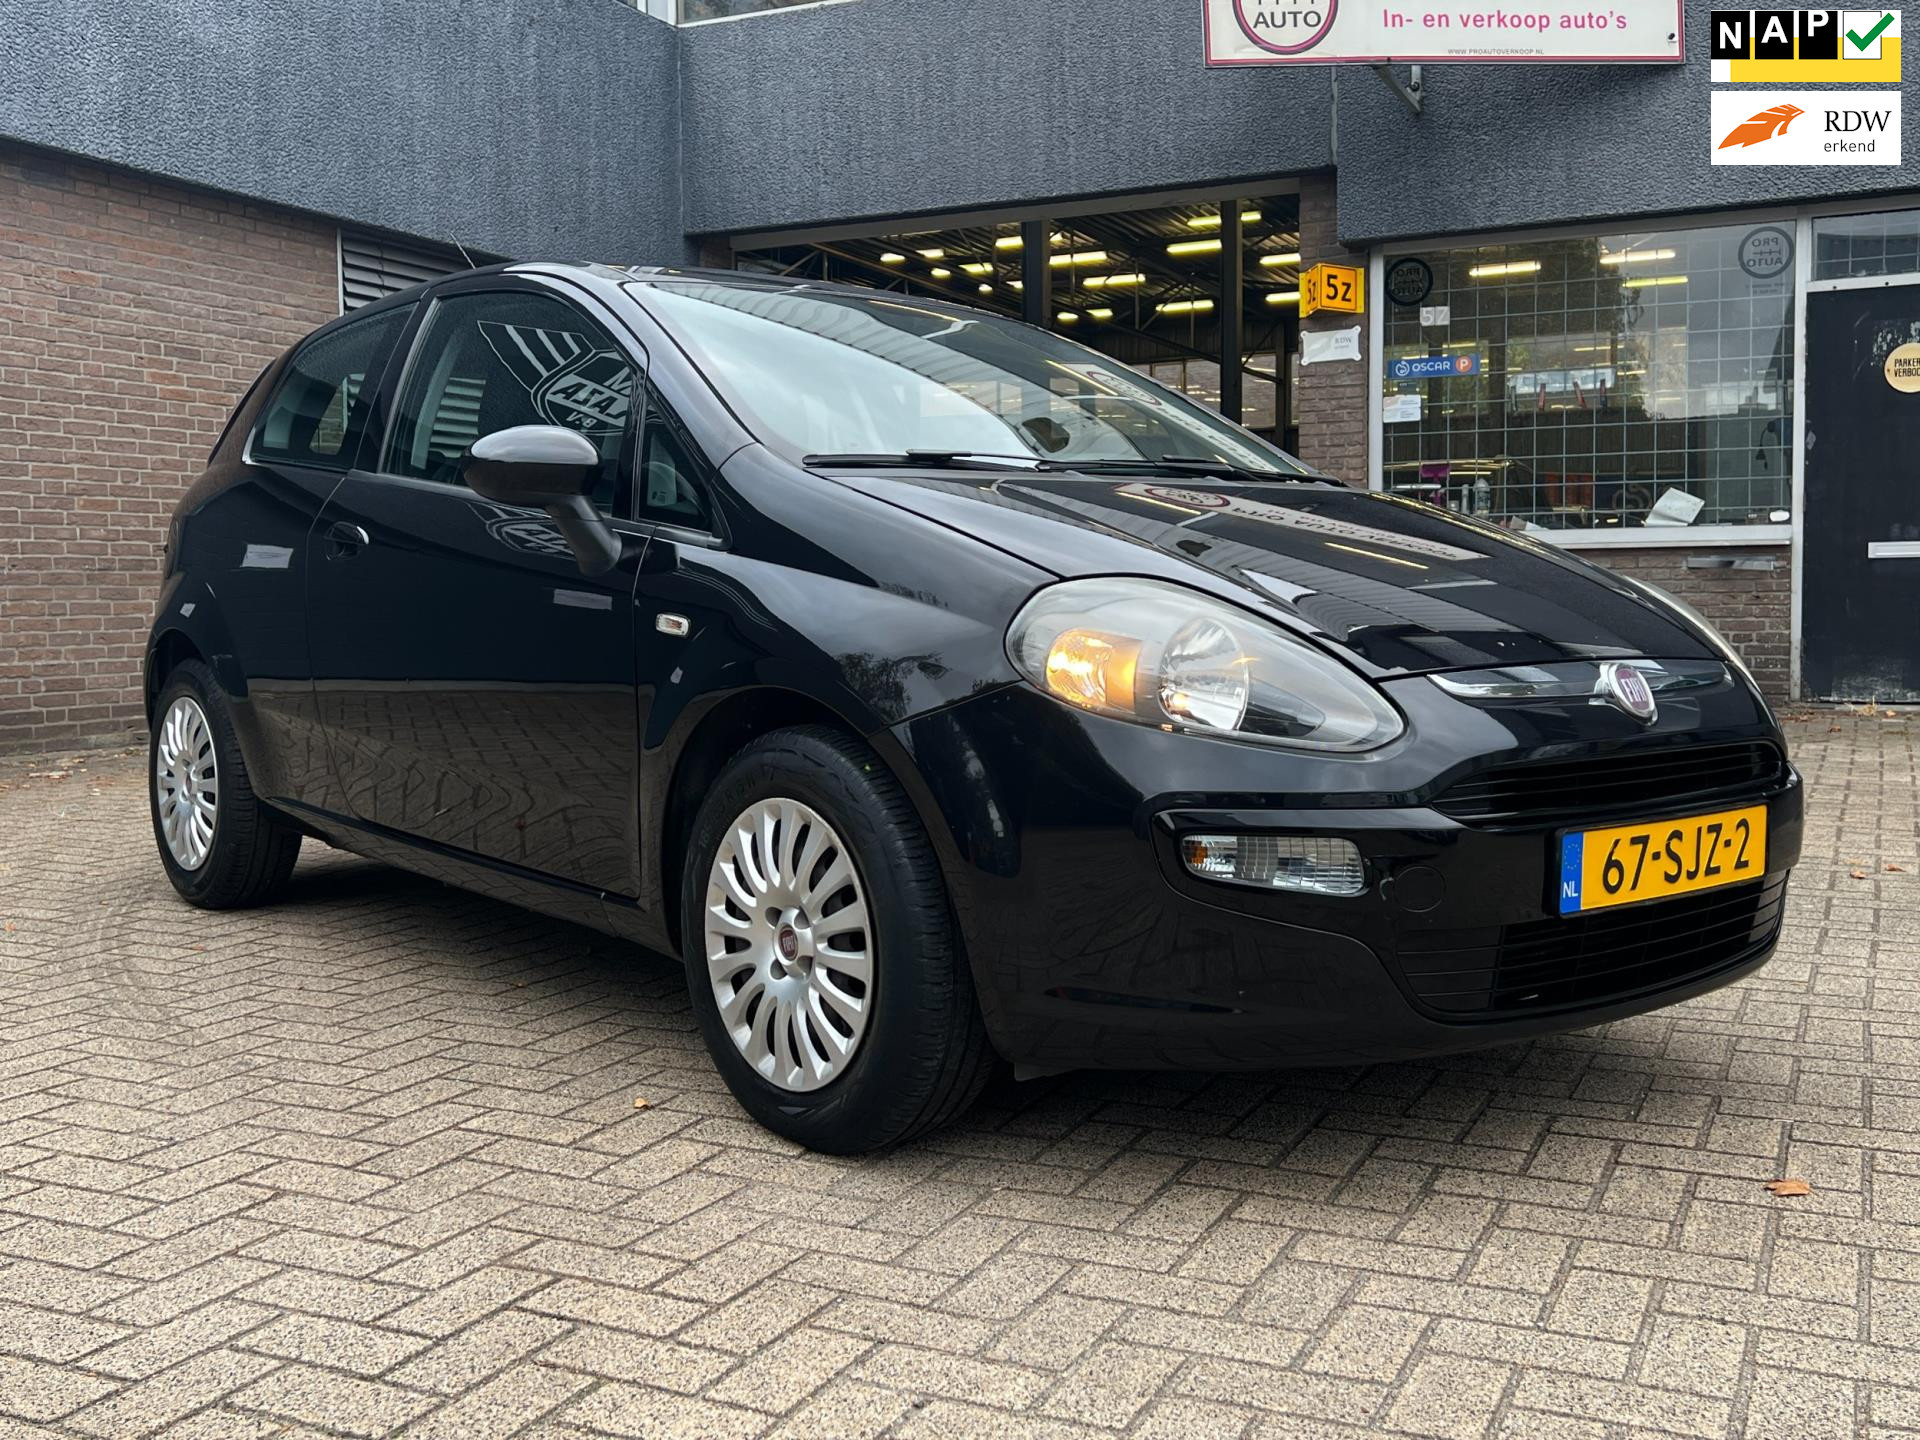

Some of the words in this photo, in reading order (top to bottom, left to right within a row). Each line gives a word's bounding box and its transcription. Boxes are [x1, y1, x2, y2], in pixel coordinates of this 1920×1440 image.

[1253, 10, 1322, 29] AUTO
[1383, 9, 1414, 28] In-
[1422, 13, 1450, 28] en
[1459, 9, 1551, 33] verkoop
[1559, 10, 1628, 29] auto's
[1411, 360, 1451, 373] OSCAR
[1602, 817, 1750, 894] 67-SJZ-2
[1562, 880, 1579, 898] NL
